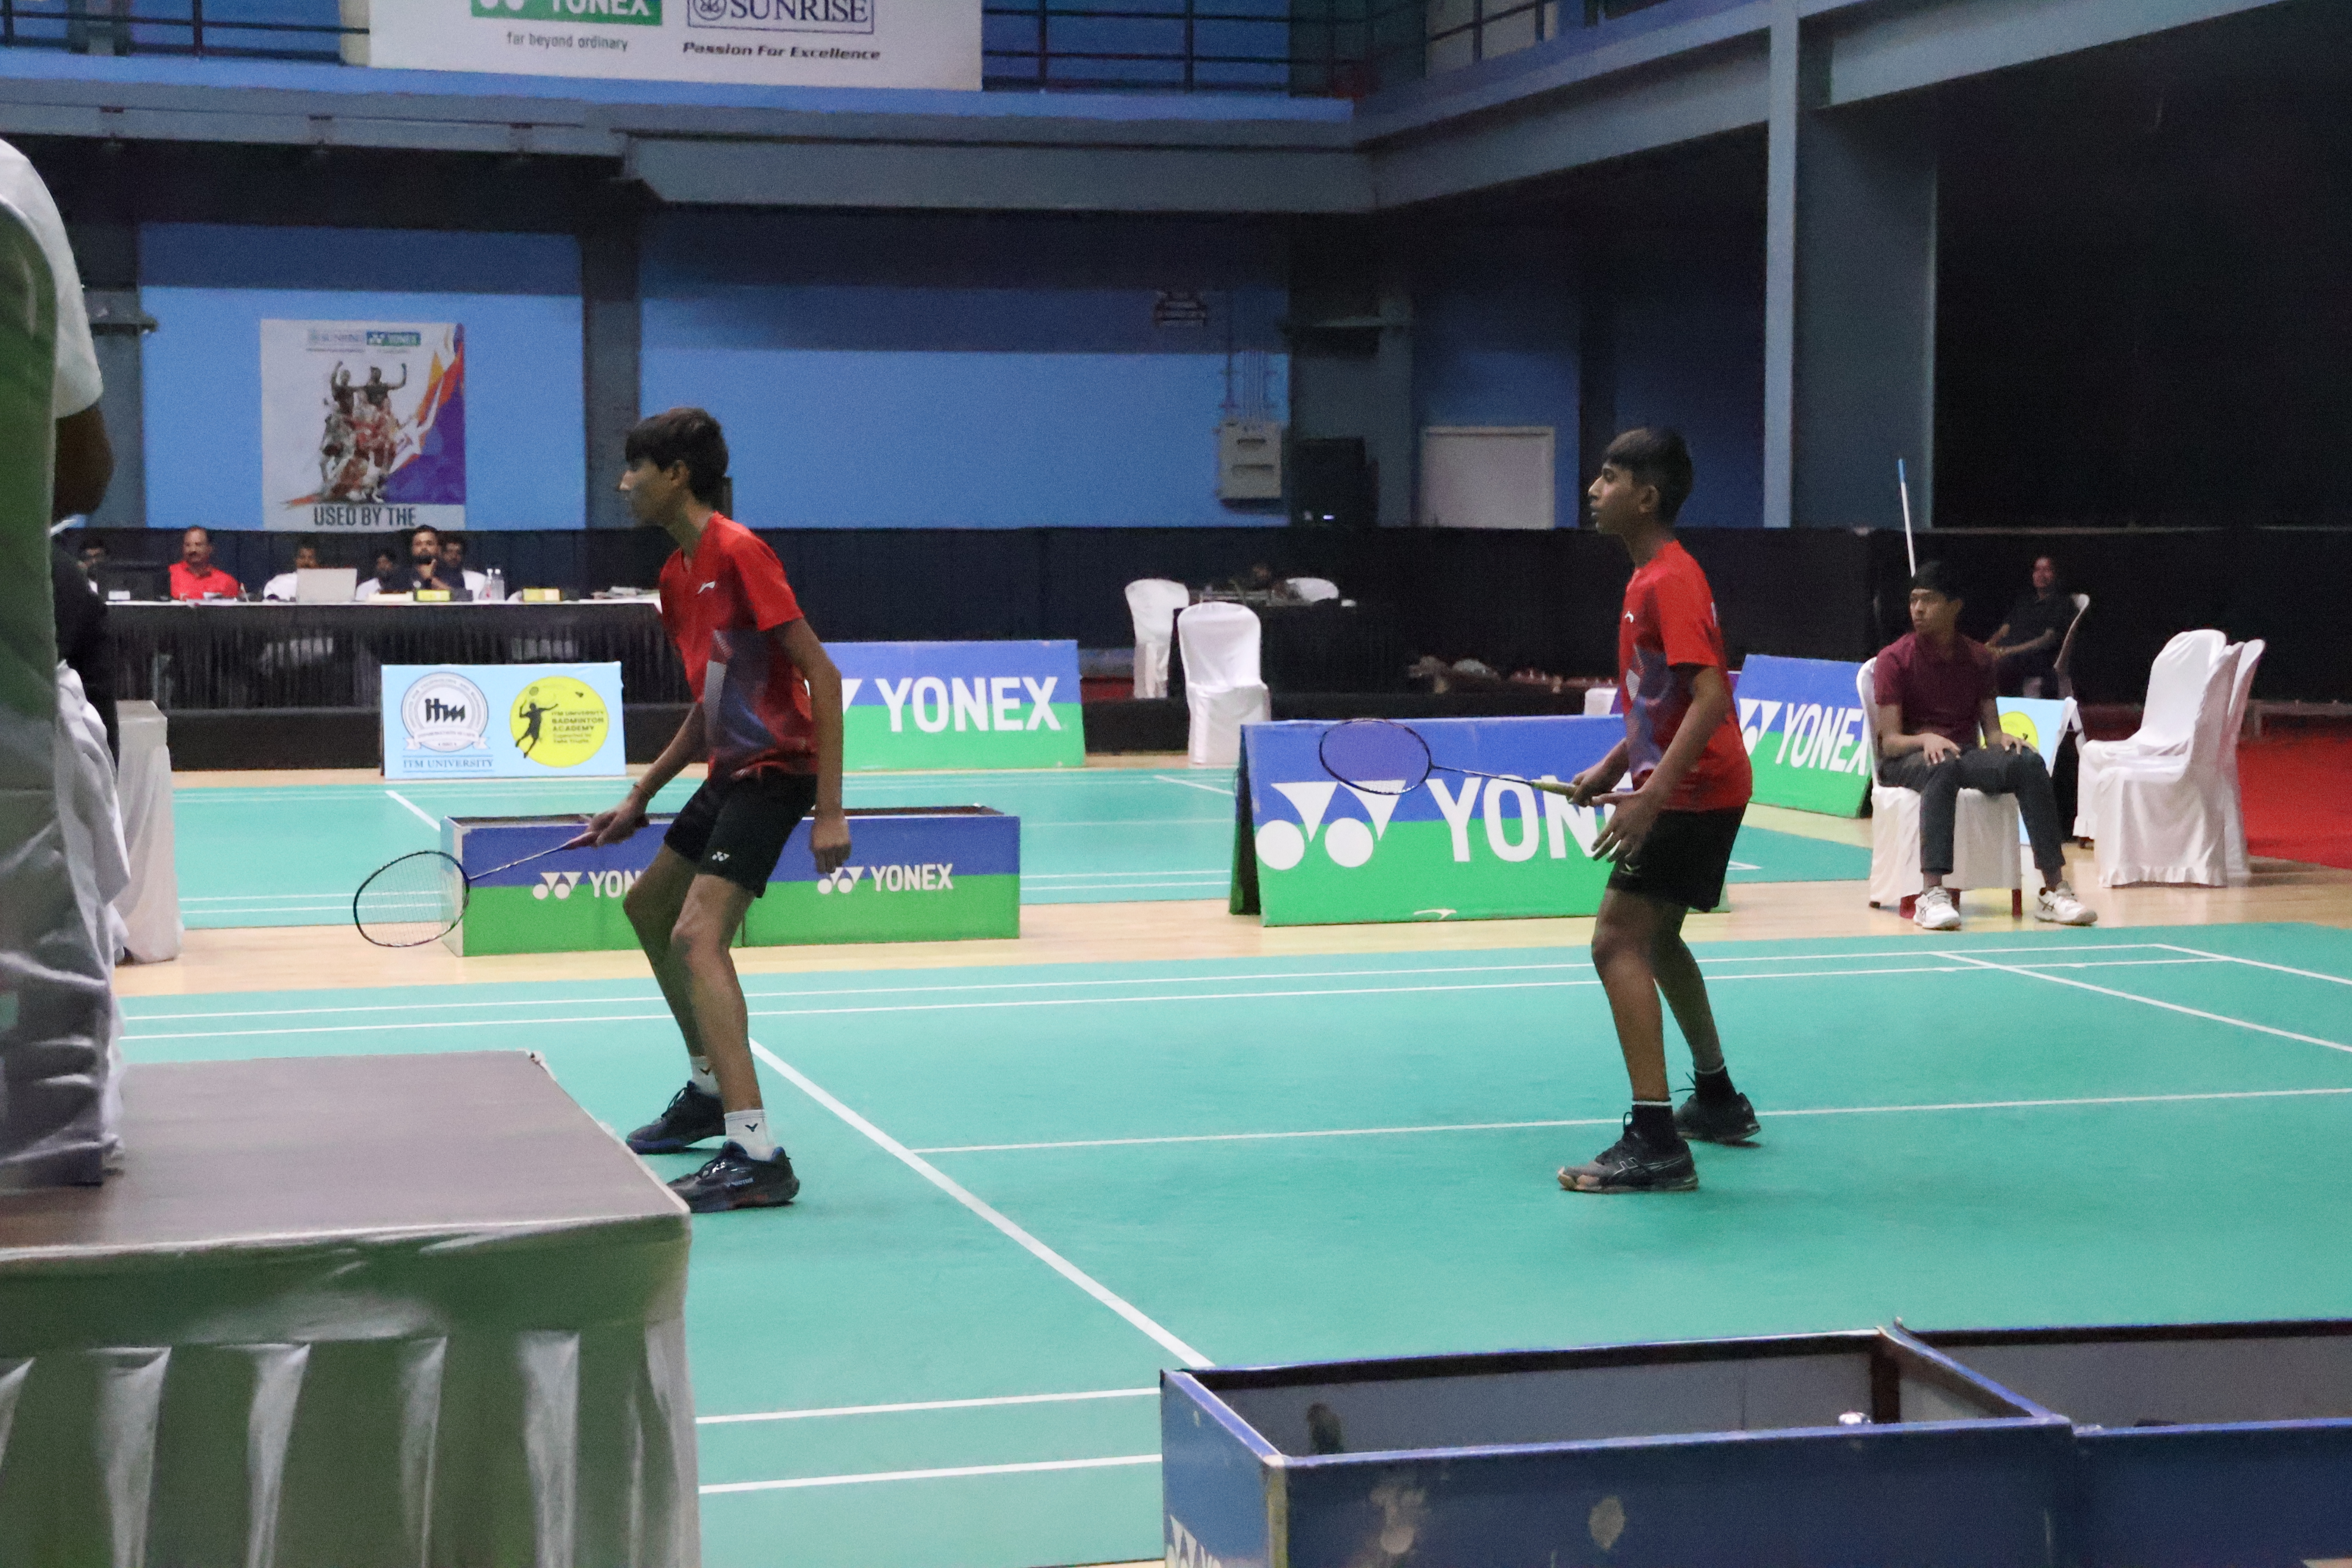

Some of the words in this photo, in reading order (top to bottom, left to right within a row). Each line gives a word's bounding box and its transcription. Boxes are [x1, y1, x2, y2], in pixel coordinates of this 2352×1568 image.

[731, 0, 868, 22] SUNRISE
[529, 33, 573, 49] beyond
[578, 35, 627, 52] ordinary
[683, 42, 752, 56] Passion
[790, 46, 880, 60] Excellence
[314, 506, 356, 526] USED
[361, 506, 381, 526] BY
[387, 507, 416, 526] THE
[875, 676, 1062, 733] YONEX
[403, 759, 423, 768] ITM
[427, 759, 494, 768] UNIVERSITY
[1426, 773, 1633, 862] YON
[588, 870, 642, 898] YON
[870, 863, 954, 892] YONEX
